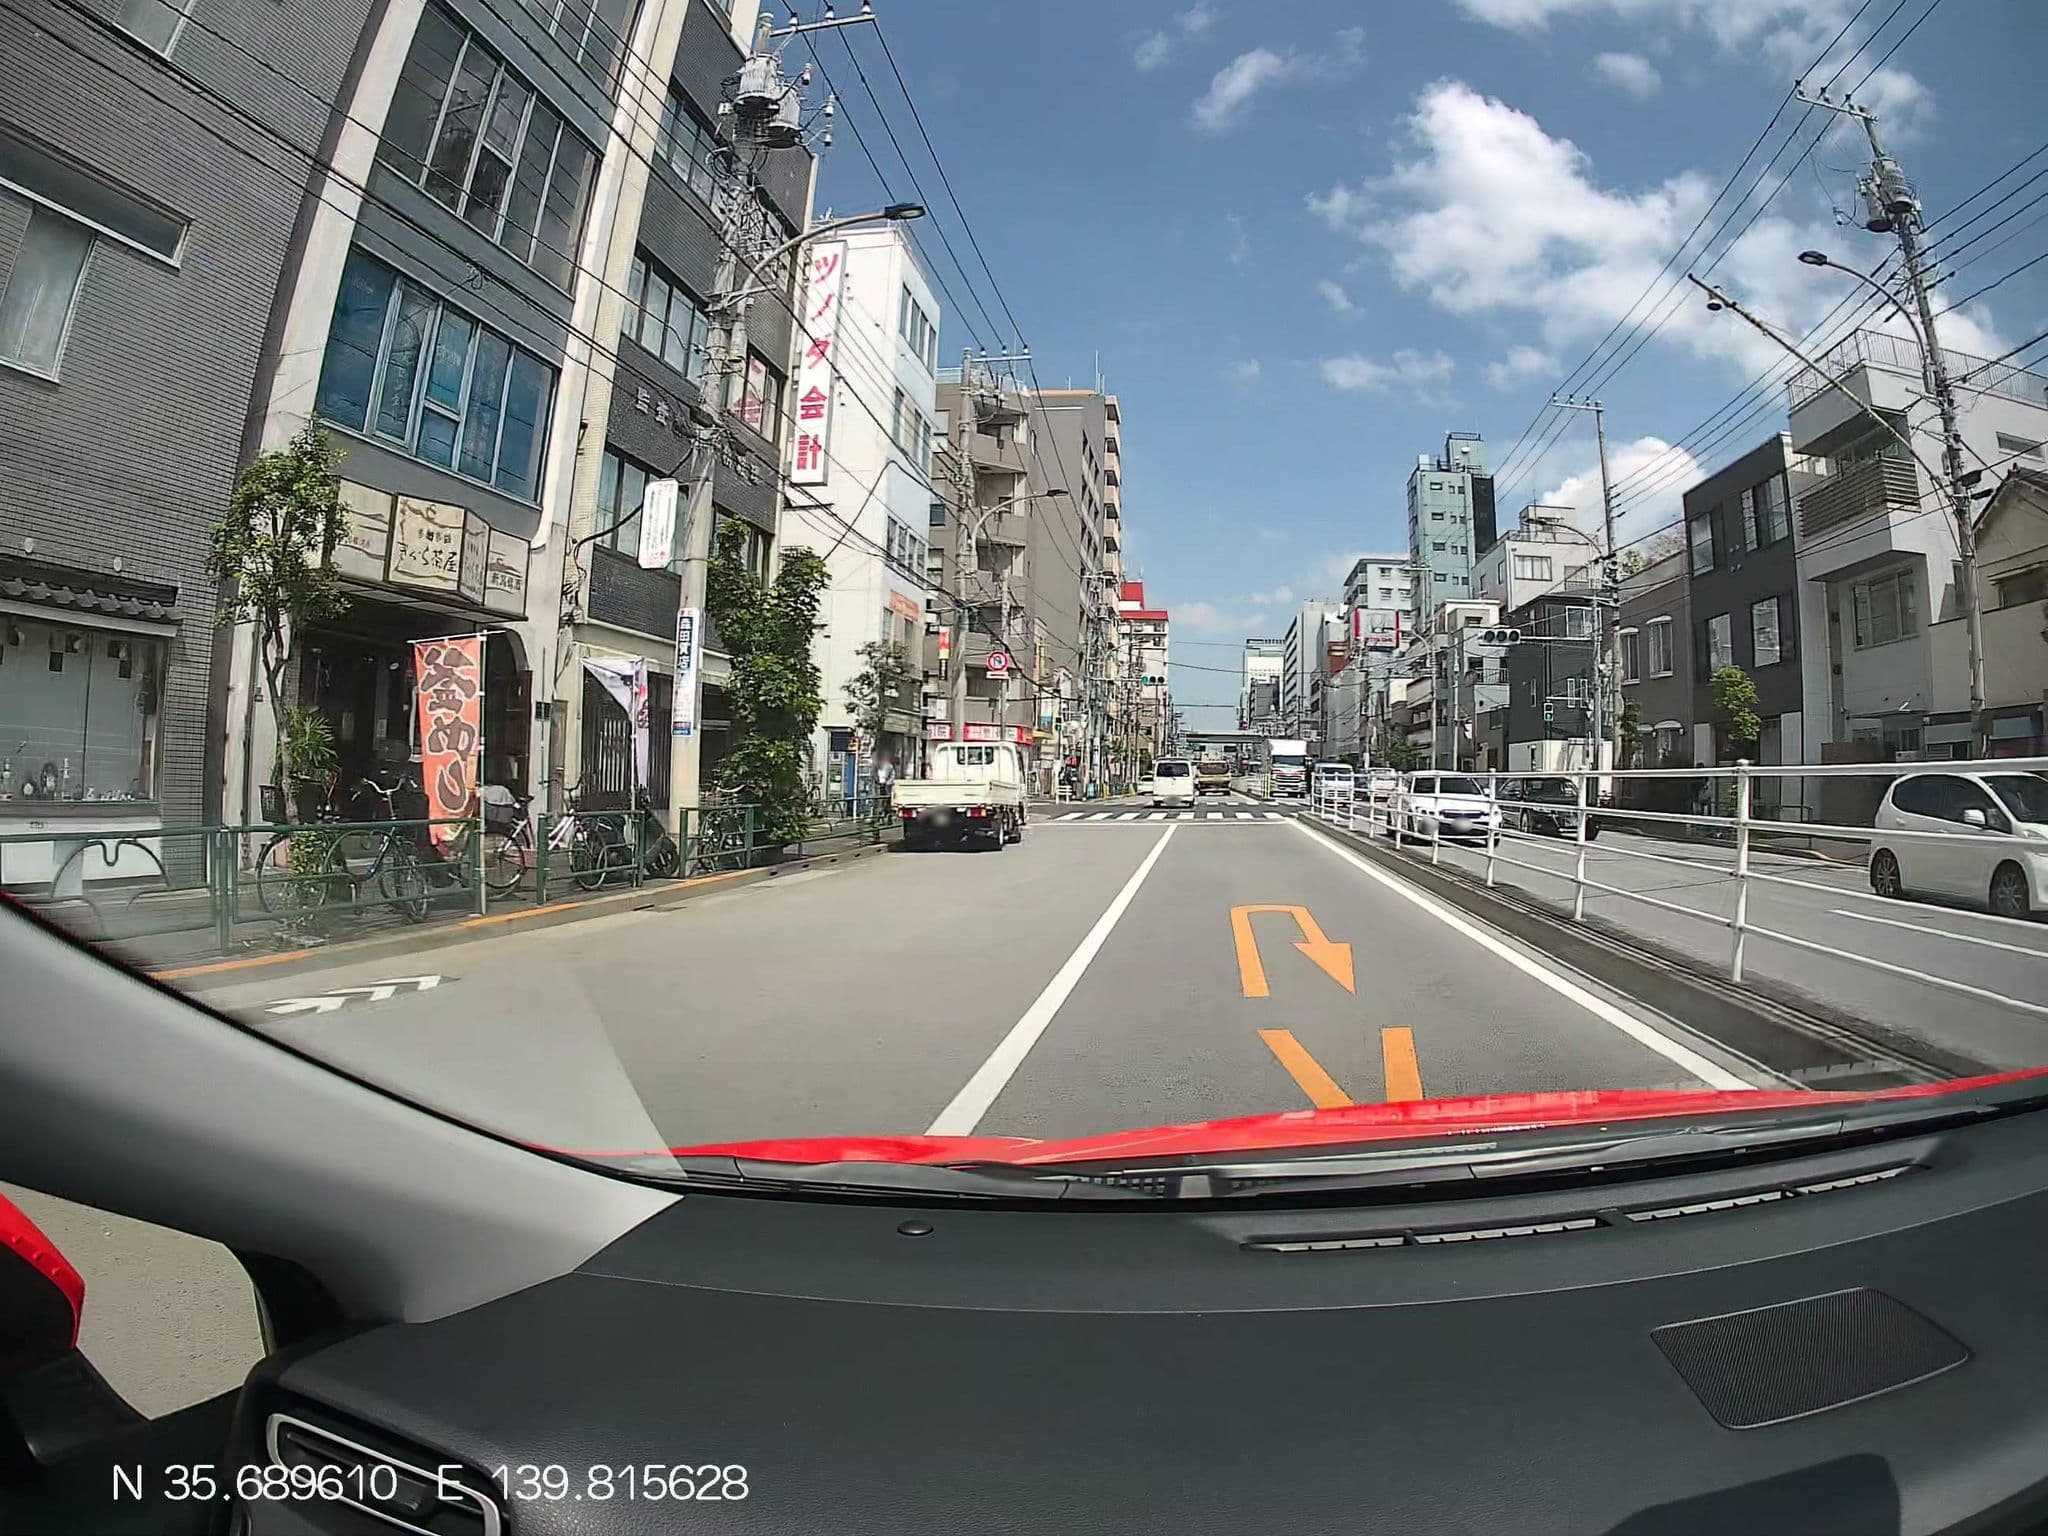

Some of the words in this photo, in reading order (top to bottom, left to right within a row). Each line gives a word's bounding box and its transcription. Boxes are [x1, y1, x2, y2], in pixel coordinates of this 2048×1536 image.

[797, 253, 840, 471] ツノダ会計
